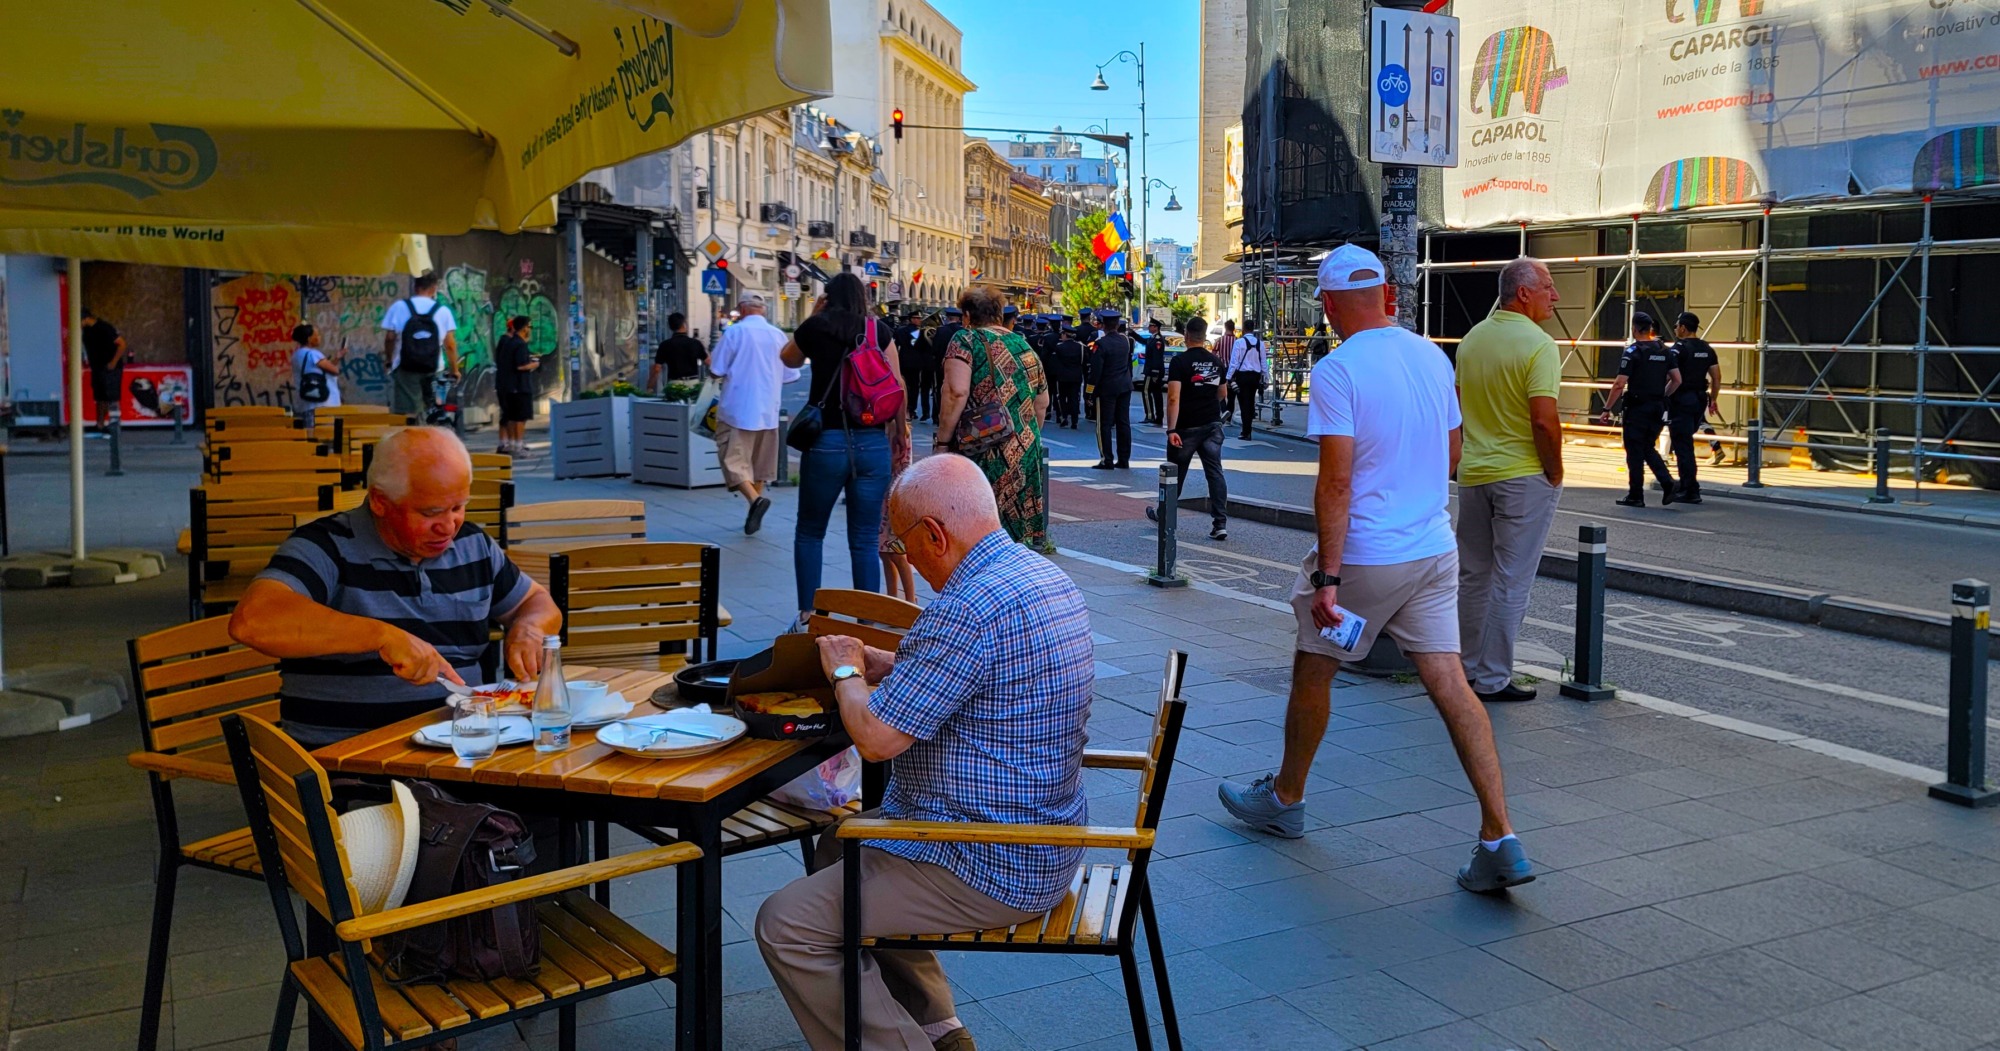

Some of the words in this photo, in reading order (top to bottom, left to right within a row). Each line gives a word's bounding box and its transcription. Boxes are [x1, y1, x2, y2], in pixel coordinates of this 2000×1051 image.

[1921, 16, 1985, 39] Inovativ
[1990, 11, 2000, 26] d
[1669, 24, 1774, 61] CAPAROL
[1662, 67, 1708, 86] Inovativ
[1711, 63, 1727, 76] de
[1731, 61, 1742, 73] la
[1747, 55, 1780, 72] 1895
[1918, 54, 2000, 80] www.ca
[1657, 90, 1775, 119] www.caparol.ro
[1471, 121, 1547, 147] CAPAROL
[1464, 153, 1498, 168] Inovativ
[1500, 150, 1513, 161] de
[1515, 149, 1523, 160] la
[1527, 151, 1551, 164] 1895
[1462, 178, 1548, 199] www.caparol.ro
[172, 226, 224, 242] World
